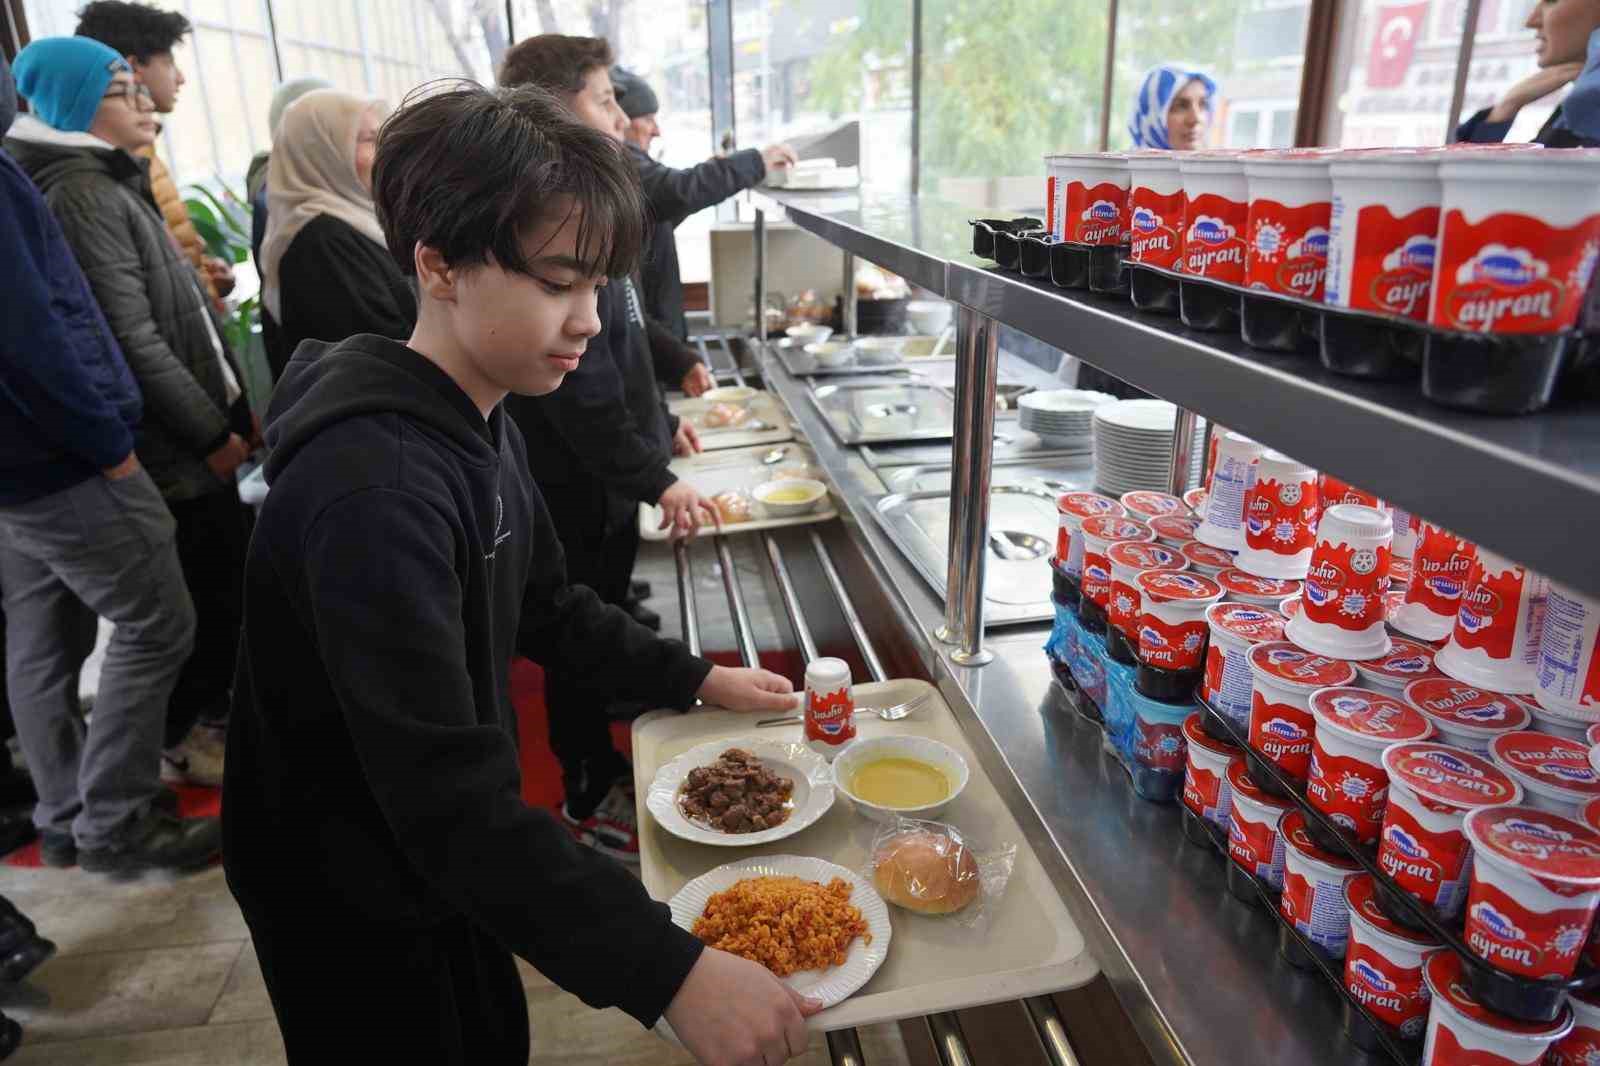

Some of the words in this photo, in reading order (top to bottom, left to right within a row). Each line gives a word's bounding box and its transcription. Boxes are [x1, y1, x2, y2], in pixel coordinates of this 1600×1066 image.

[1085, 223, 1121, 246] ayran
[1188, 246, 1243, 276] ayran
[1290, 268, 1327, 297] ayr
[1386, 279, 1432, 316] ayr
[1458, 291, 1552, 333] ayran
[1263, 741, 1312, 761] ayran
[1412, 766, 1496, 797] ayran
[1381, 851, 1436, 882] ayran
[1469, 931, 1534, 967] ayran
[1350, 983, 1406, 1012] ayran
